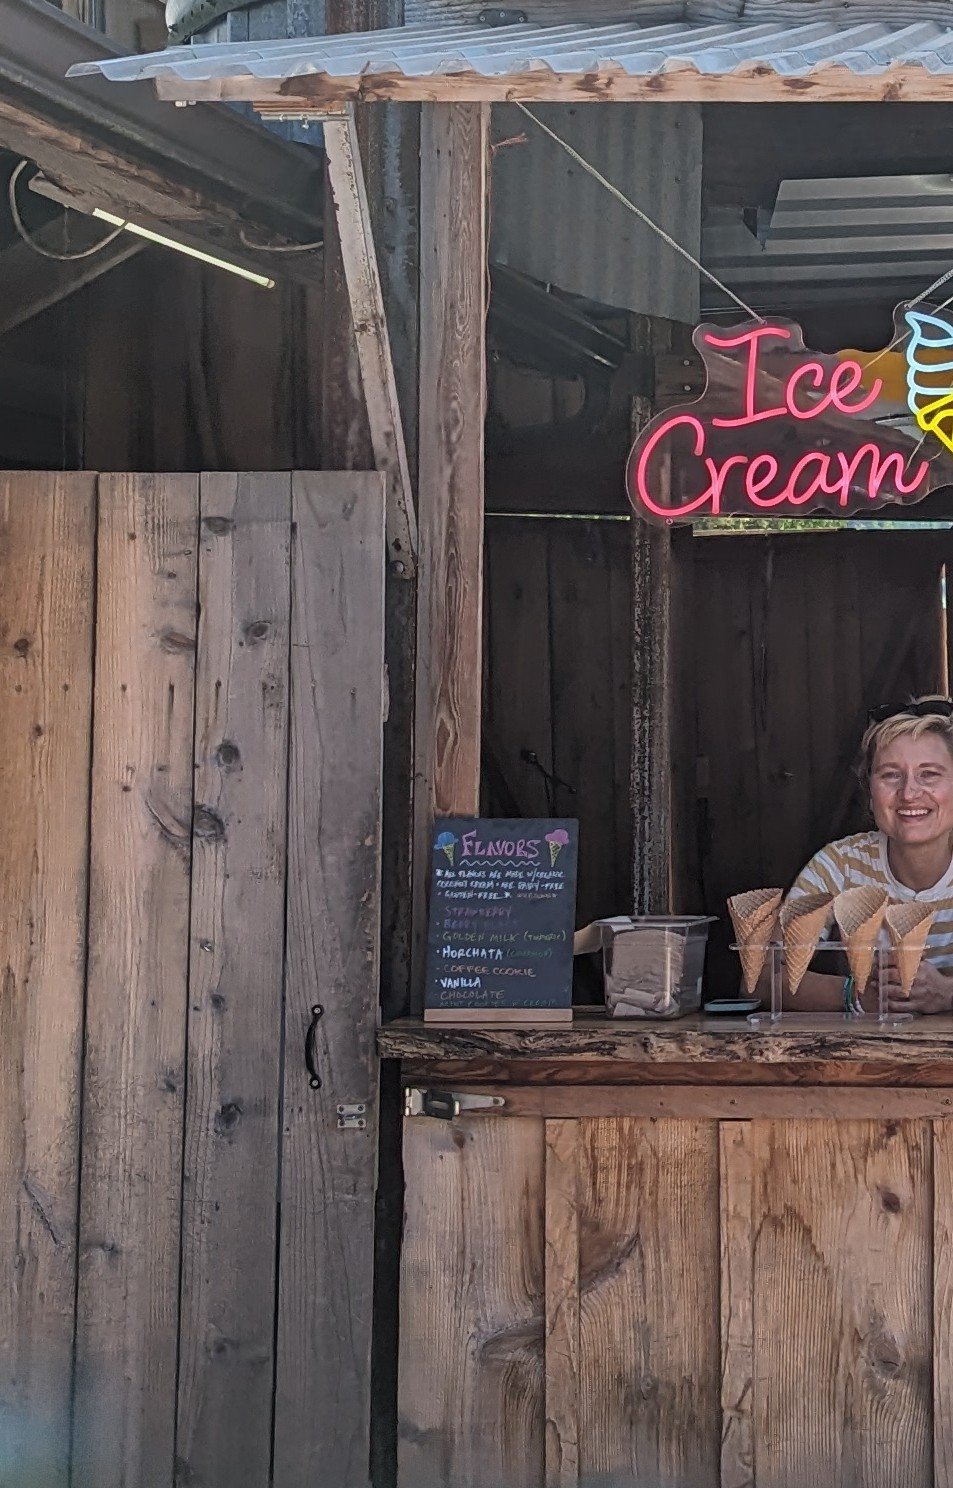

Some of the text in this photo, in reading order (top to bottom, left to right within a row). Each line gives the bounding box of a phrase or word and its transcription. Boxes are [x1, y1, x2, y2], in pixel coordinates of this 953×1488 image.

[703, 325, 884, 428] Ice
[636, 414, 930, 516] Cream
[461, 829, 541, 859] FLAVORS
[442, 931, 485, 942] GOLDEN
[490, 932, 520, 942] MILK
[442, 945, 503, 960] HORCHATA
[444, 964, 537, 978] COFFEE COOKIE
[440, 976, 482, 988] VANILLA
[440, 990, 505, 1000] CHOCOLATE
